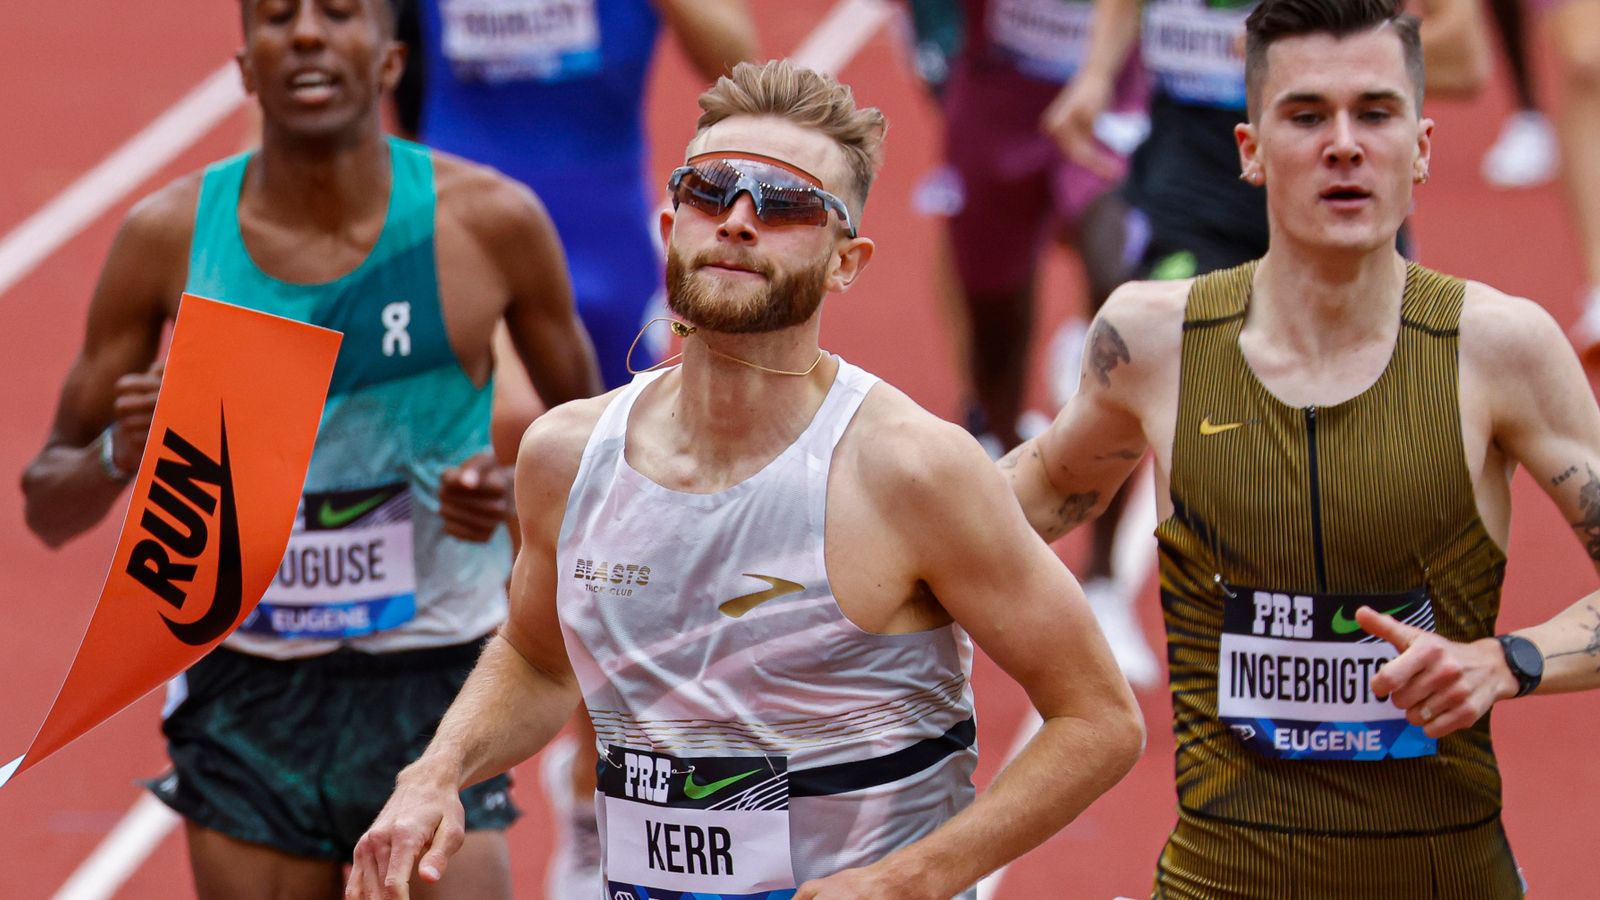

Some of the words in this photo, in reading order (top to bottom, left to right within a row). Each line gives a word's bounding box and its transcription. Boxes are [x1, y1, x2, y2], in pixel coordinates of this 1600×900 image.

[125, 427, 222, 610] RUN
[279, 538, 387, 588] UGUSE
[574, 558, 651, 587] BEASTS
[609, 587, 633, 597] CLUB
[1252, 590, 1314, 640] PRE
[271, 604, 371, 633] EUGENE
[1274, 727, 1382, 751] EUGENE
[624, 752, 672, 804] PRE
[645, 819, 734, 876] KERR
